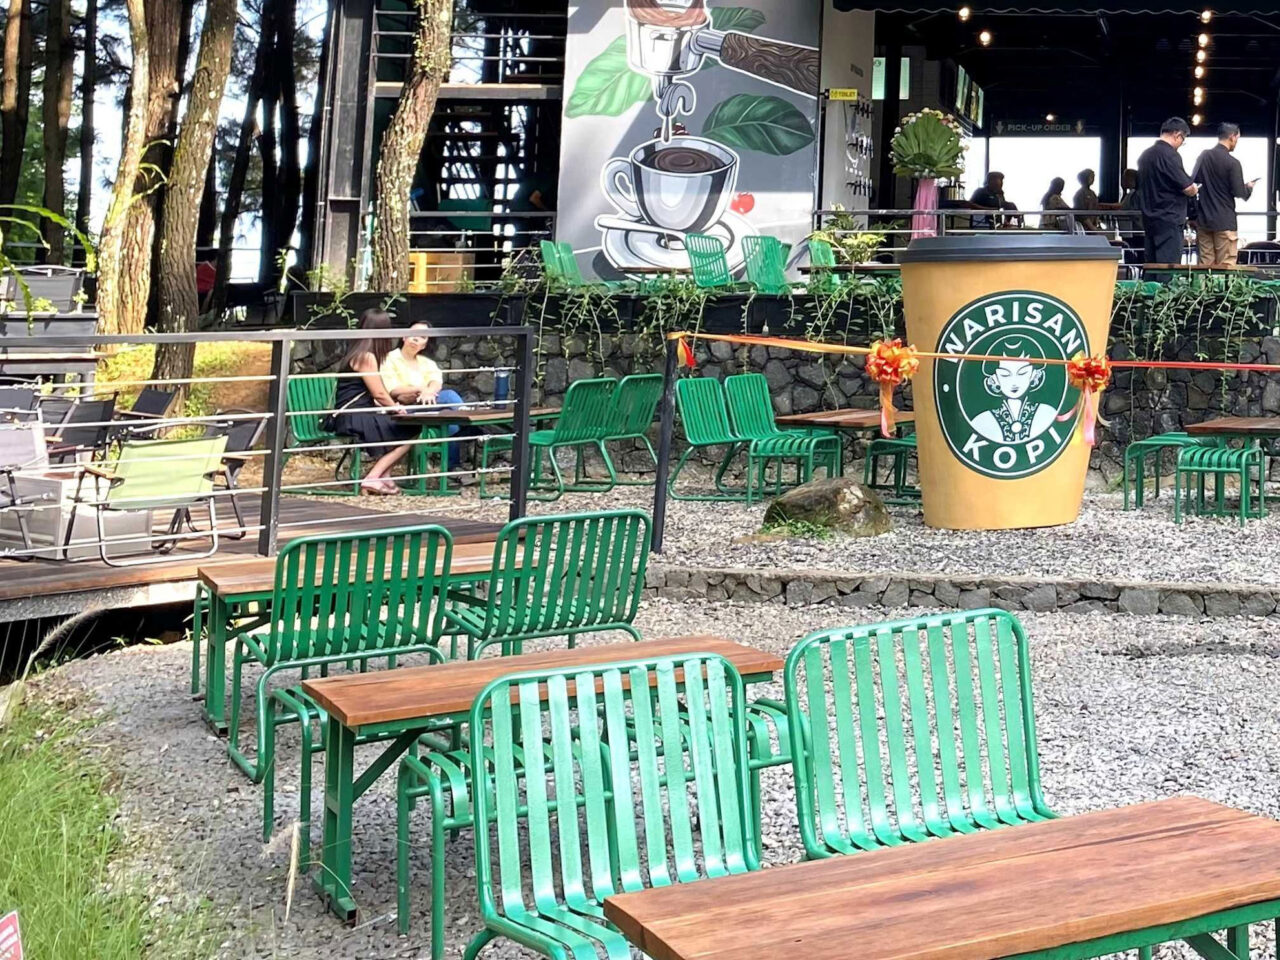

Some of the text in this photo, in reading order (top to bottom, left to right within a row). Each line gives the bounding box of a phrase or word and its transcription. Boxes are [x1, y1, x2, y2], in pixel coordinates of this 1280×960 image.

[1007, 124, 1041, 132] PICK-UP
[942, 300, 1082, 364] WARISAN
[962, 427, 1062, 470] KOPI
